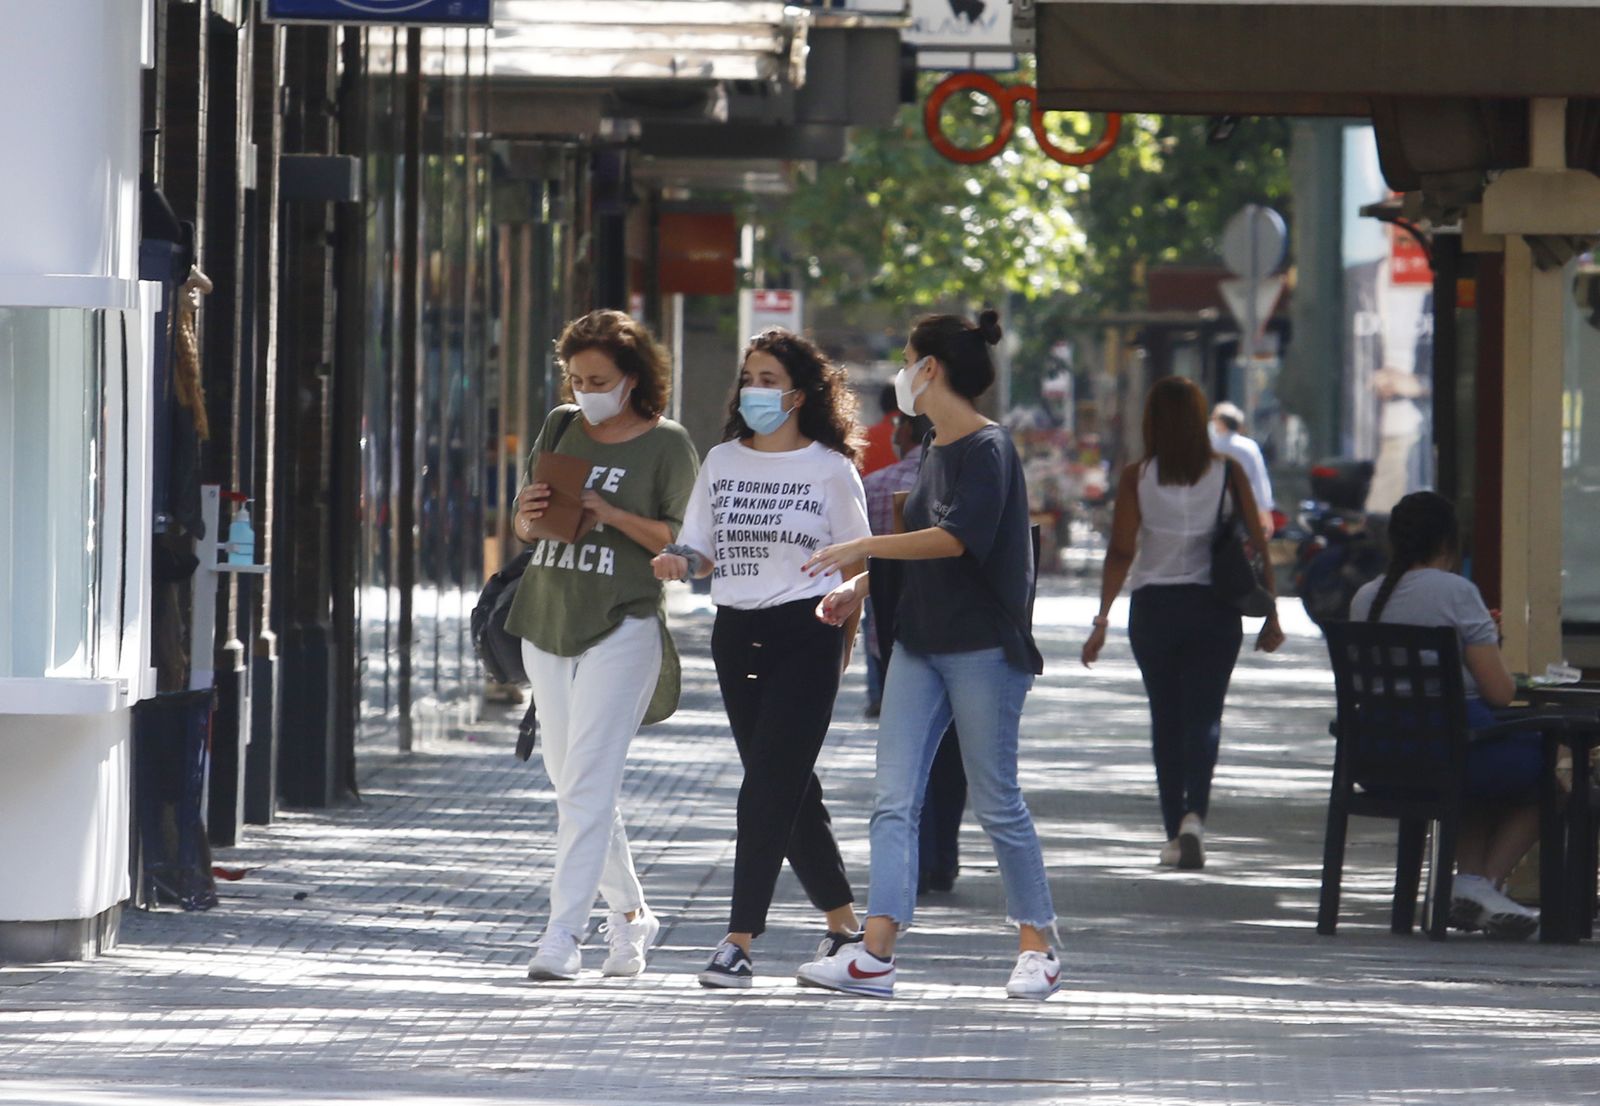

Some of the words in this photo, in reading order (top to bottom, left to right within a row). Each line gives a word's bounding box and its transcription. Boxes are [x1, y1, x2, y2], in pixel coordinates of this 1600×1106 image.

[737, 481, 780, 495] BORING
[782, 483, 811, 495] DAYS
[733, 497, 777, 509] WAKING
[779, 498, 793, 510] UP
[727, 512, 783, 525] MONDAYS
[727, 530, 778, 542] MORNING
[531, 540, 615, 575] BEACH
[728, 547, 769, 559] STRESS
[731, 563, 759, 576] LISTS
